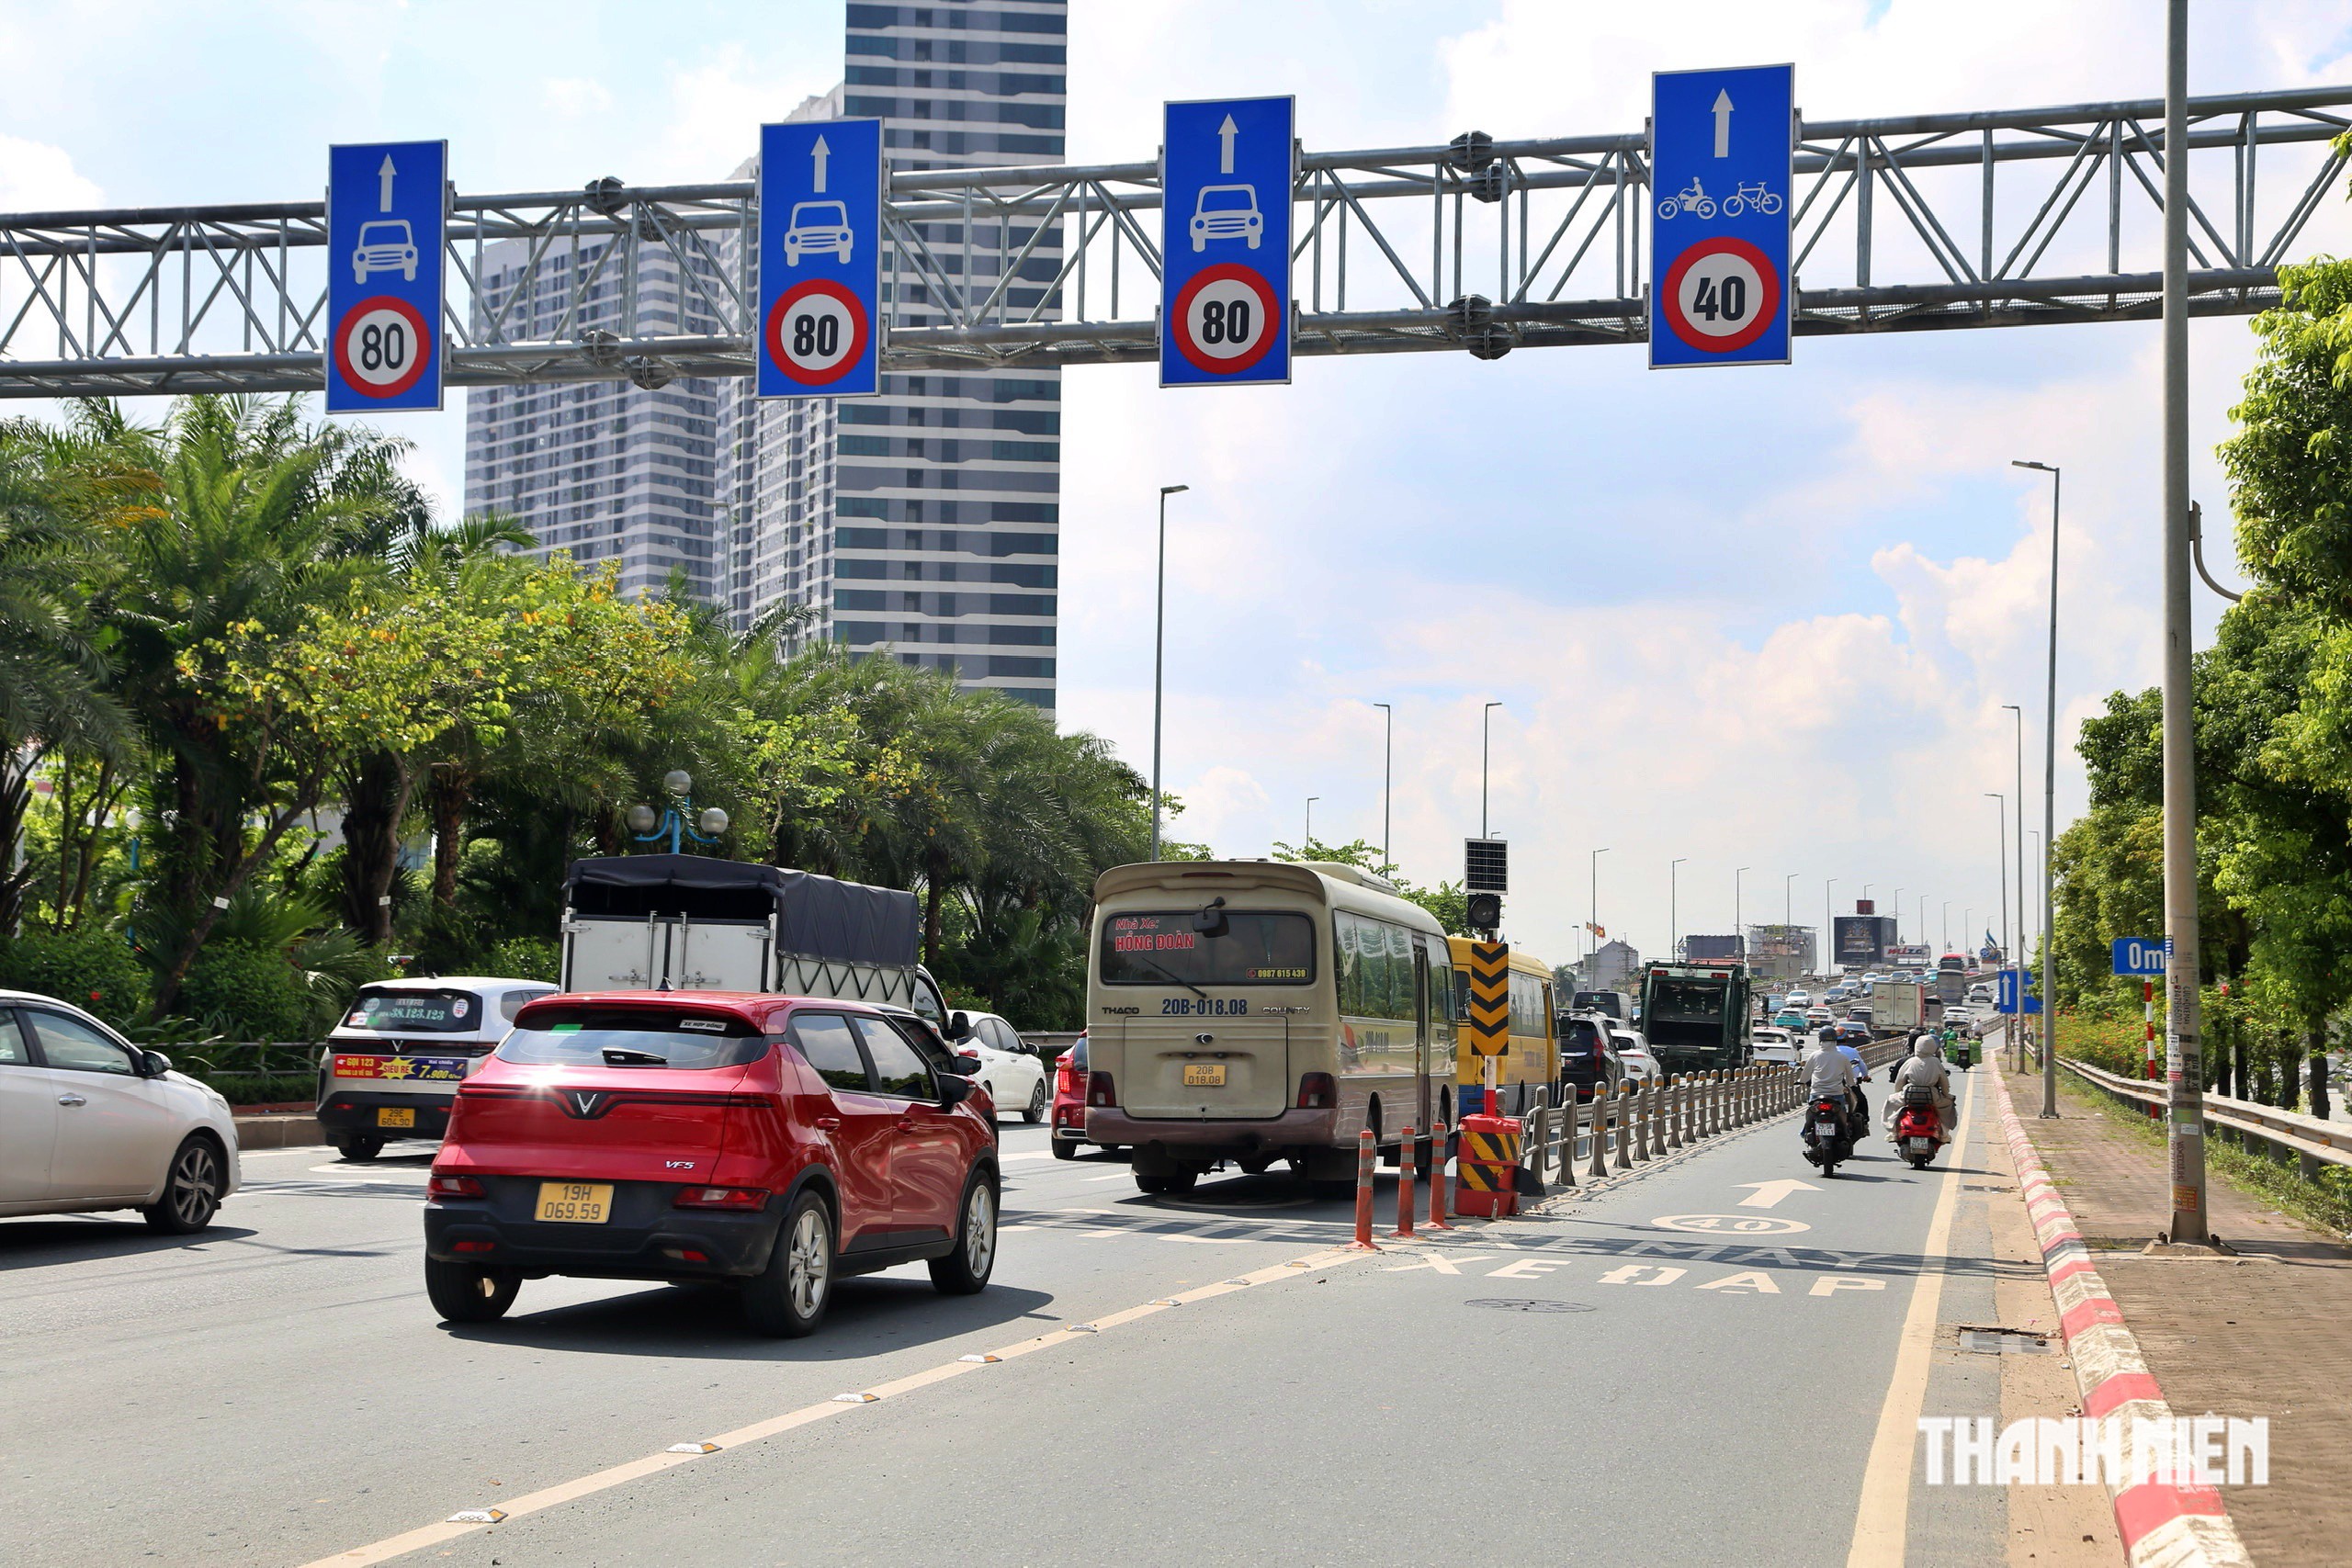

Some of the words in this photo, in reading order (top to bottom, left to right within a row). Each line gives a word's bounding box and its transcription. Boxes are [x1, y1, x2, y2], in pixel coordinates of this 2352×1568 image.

[1692, 276, 1746, 321] 40
[1202, 300, 1250, 344] 80
[793, 313, 838, 357] 80
[361, 323, 405, 370] 80
[1115, 918, 1138, 930] Nhà
[1139, 918, 1159, 930] Xe:
[1115, 931, 1153, 952] HỒNG
[1156, 931, 1194, 950] ĐOÀN
[1258, 969, 1274, 978] 0987
[1276, 969, 1291, 978] 615
[1292, 969, 1306, 977] 439
[1162, 998, 1248, 1015] 20B-018.08
[361, 1058, 375, 1066] 123
[1196, 1066, 1214, 1075] 20B
[1188, 1076, 1221, 1084] 018.08
[665, 1160, 695, 1169] VF5
[562, 1185, 593, 1201] 19H
[544, 1201, 601, 1220] 069.59
[1679, 1218, 1772, 1231] 40
[1375, 1253, 1573, 1280] XE
